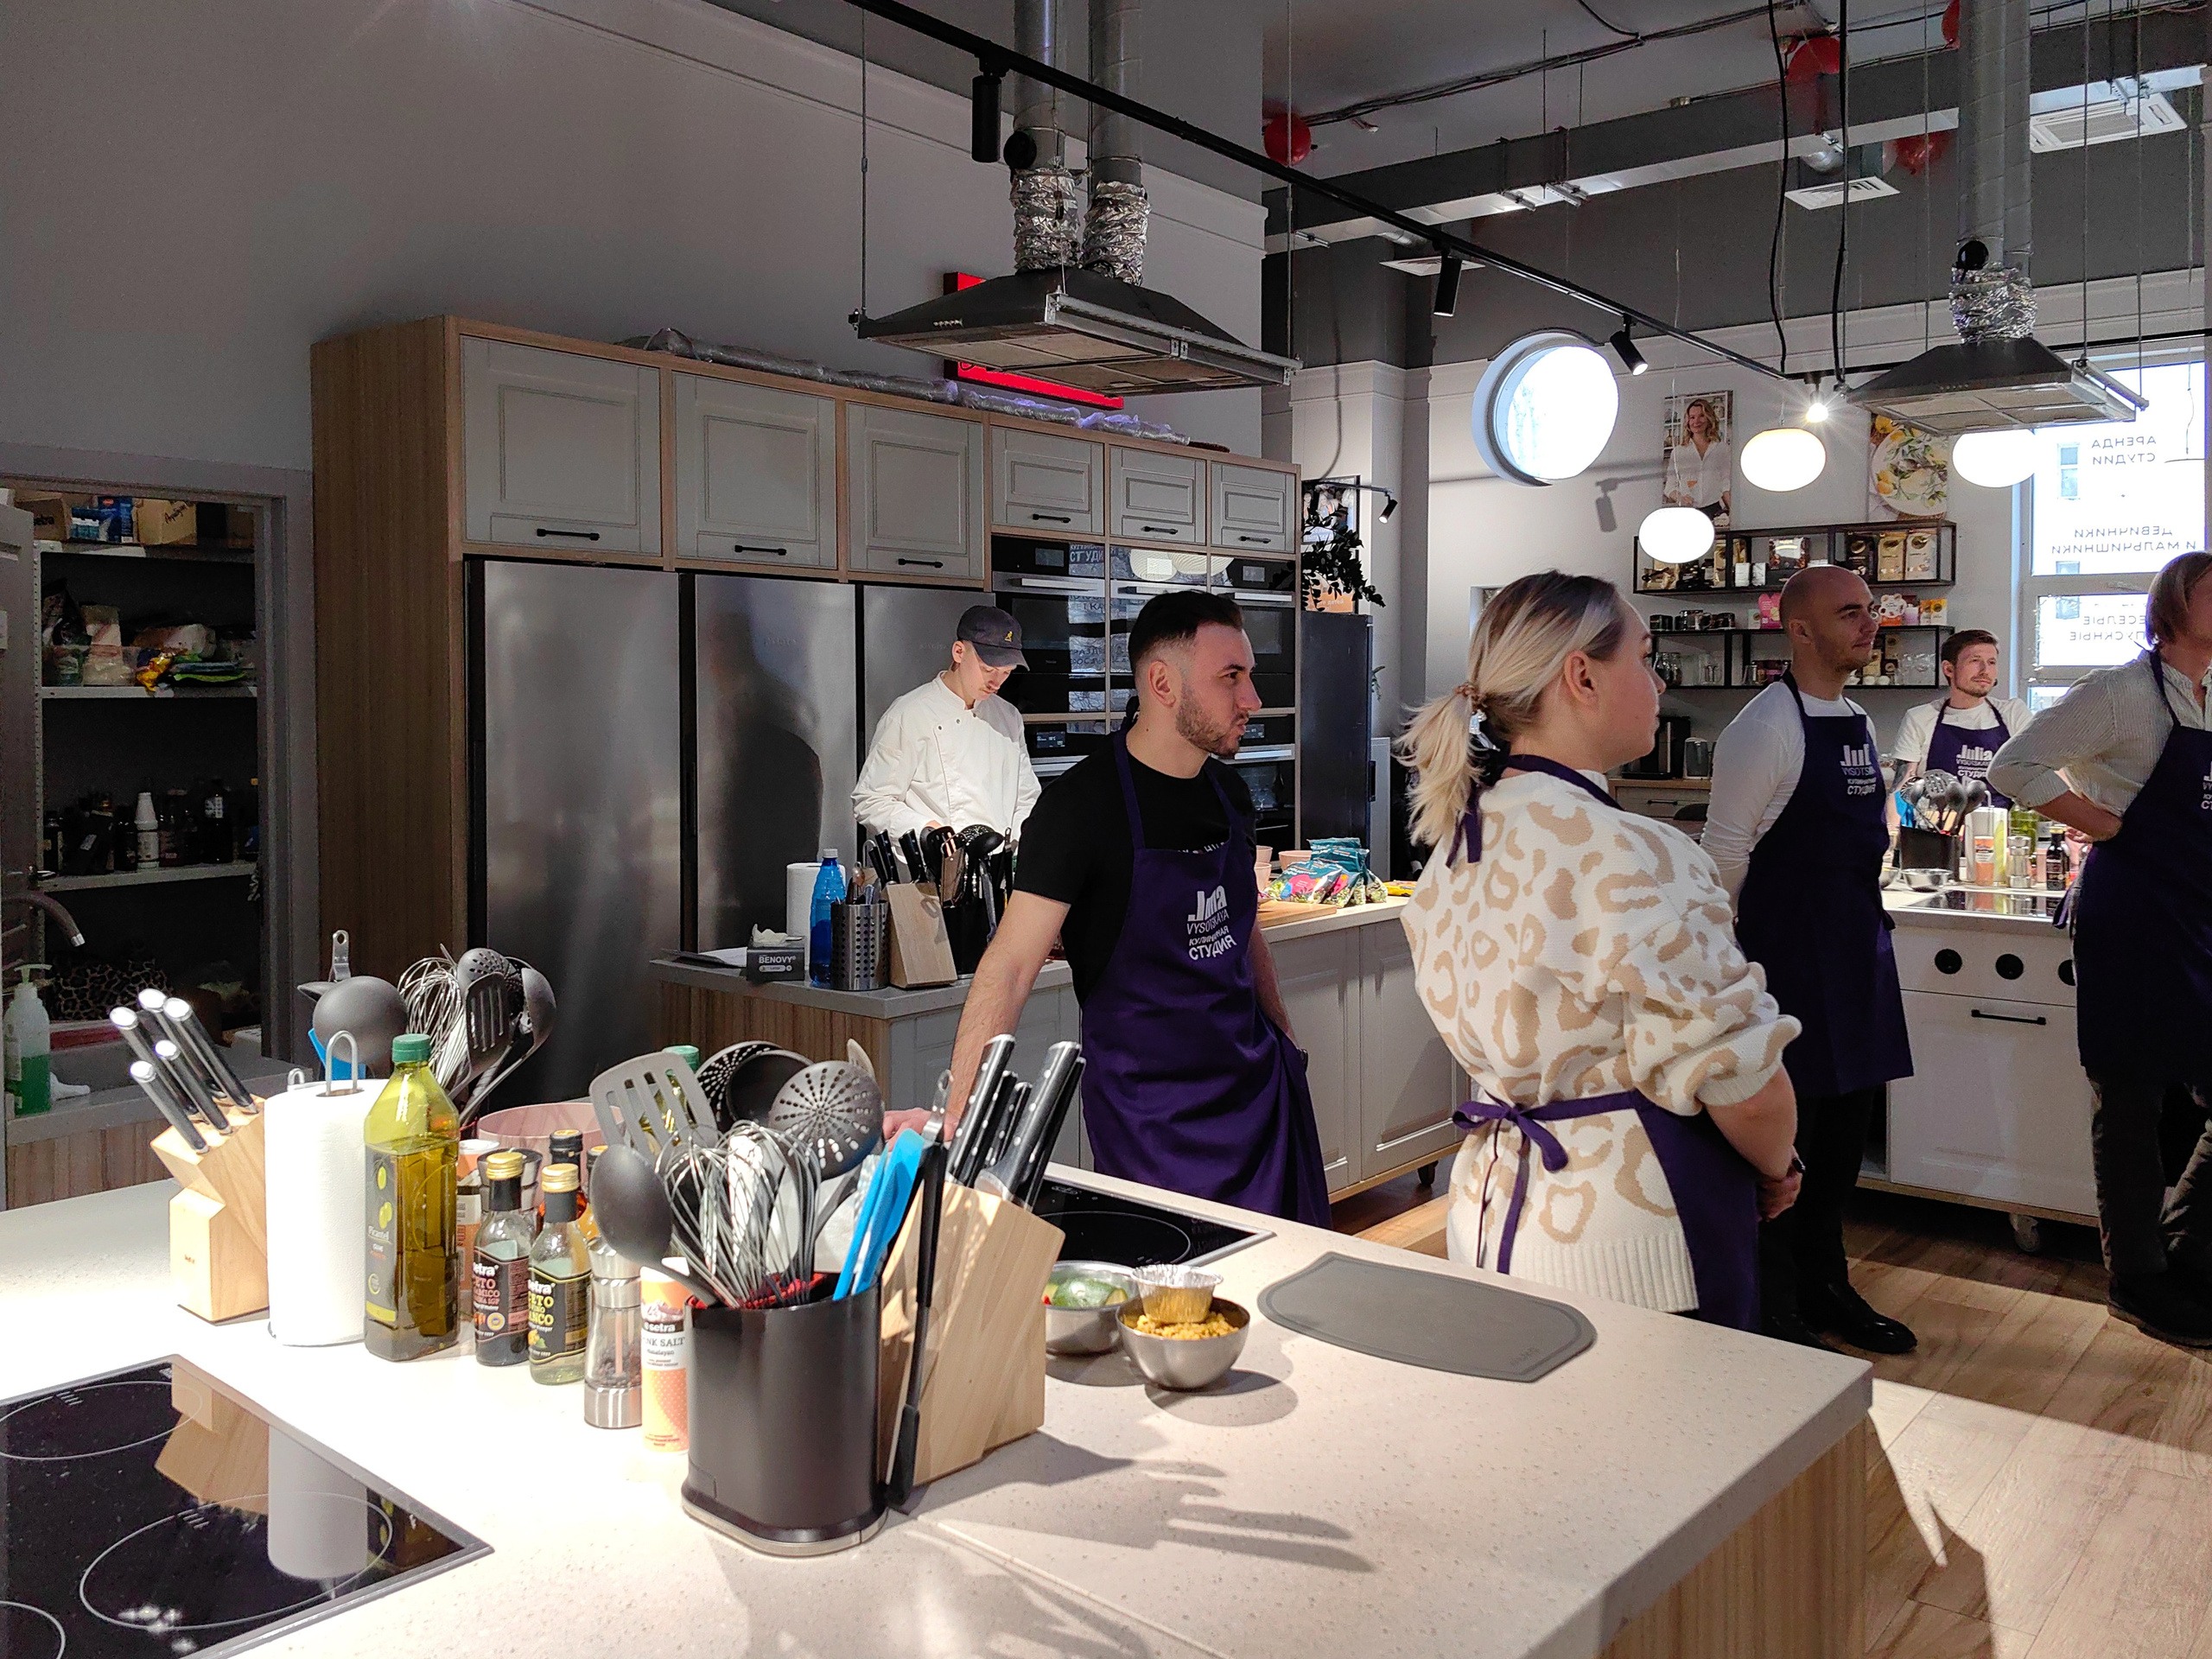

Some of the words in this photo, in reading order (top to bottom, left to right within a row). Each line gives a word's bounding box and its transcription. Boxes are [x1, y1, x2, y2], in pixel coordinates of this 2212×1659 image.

[1956, 744, 1993, 761] Julia
[1188, 934, 1237, 961] СТУДИЯ
[660, 1337, 684, 1347] SALT
